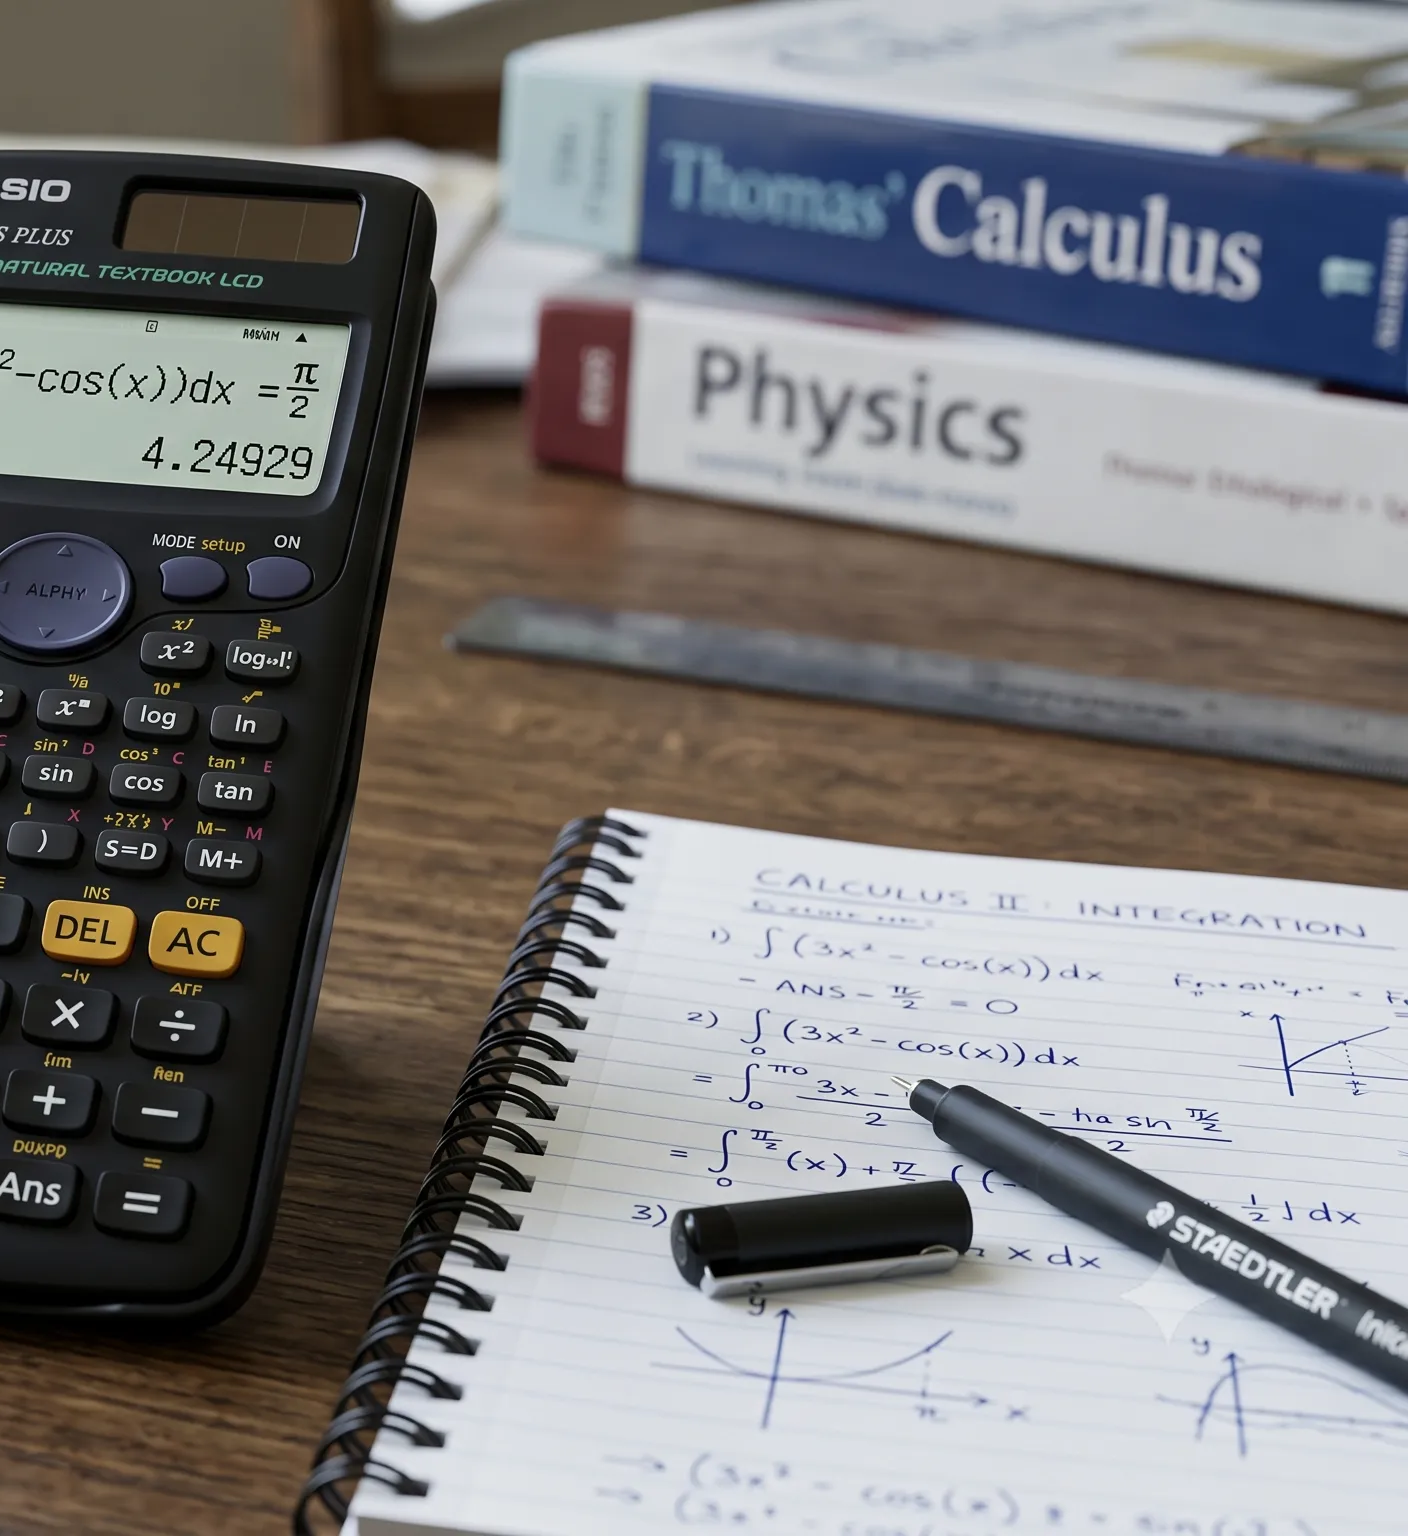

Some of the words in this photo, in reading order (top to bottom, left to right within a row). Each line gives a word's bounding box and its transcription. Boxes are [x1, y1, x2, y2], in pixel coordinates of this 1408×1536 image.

[11, 226, 73, 246] PLUS
[911, 164, 1263, 302] Calculus
[98, 264, 216, 287] TEXTBOOK
[220, 271, 264, 290] LCD
[692, 345, 1029, 467] Physics
[141, 436, 315, 481] 4.24929
[152, 533, 196, 551] MODE
[201, 536, 246, 554] setup
[274, 534, 301, 551] ON
[25, 583, 86, 601] ALPHY
[140, 704, 177, 730] log
[234, 713, 257, 734] ln
[82, 742, 95, 755] D
[172, 751, 184, 765] C
[39, 763, 74, 783] sin
[263, 760, 273, 773] E
[124, 775, 164, 792] cos
[214, 781, 253, 801] tan
[67, 808, 80, 823] X
[161, 817, 175, 832] Y
[245, 826, 263, 841] M
[198, 848, 243, 870] M+
[83, 885, 111, 900] INS
[185, 896, 221, 911] OFF
[755, 868, 970, 908] CALCULUS
[1078, 900, 1367, 939] INTEGRATION
[54, 914, 117, 946] DEL
[165, 927, 221, 957] AC
[775, 979, 846, 1000] ANS
[631, 1203, 668, 1228] 3)
[1169, 1214, 1340, 1320] STAEDTLER
